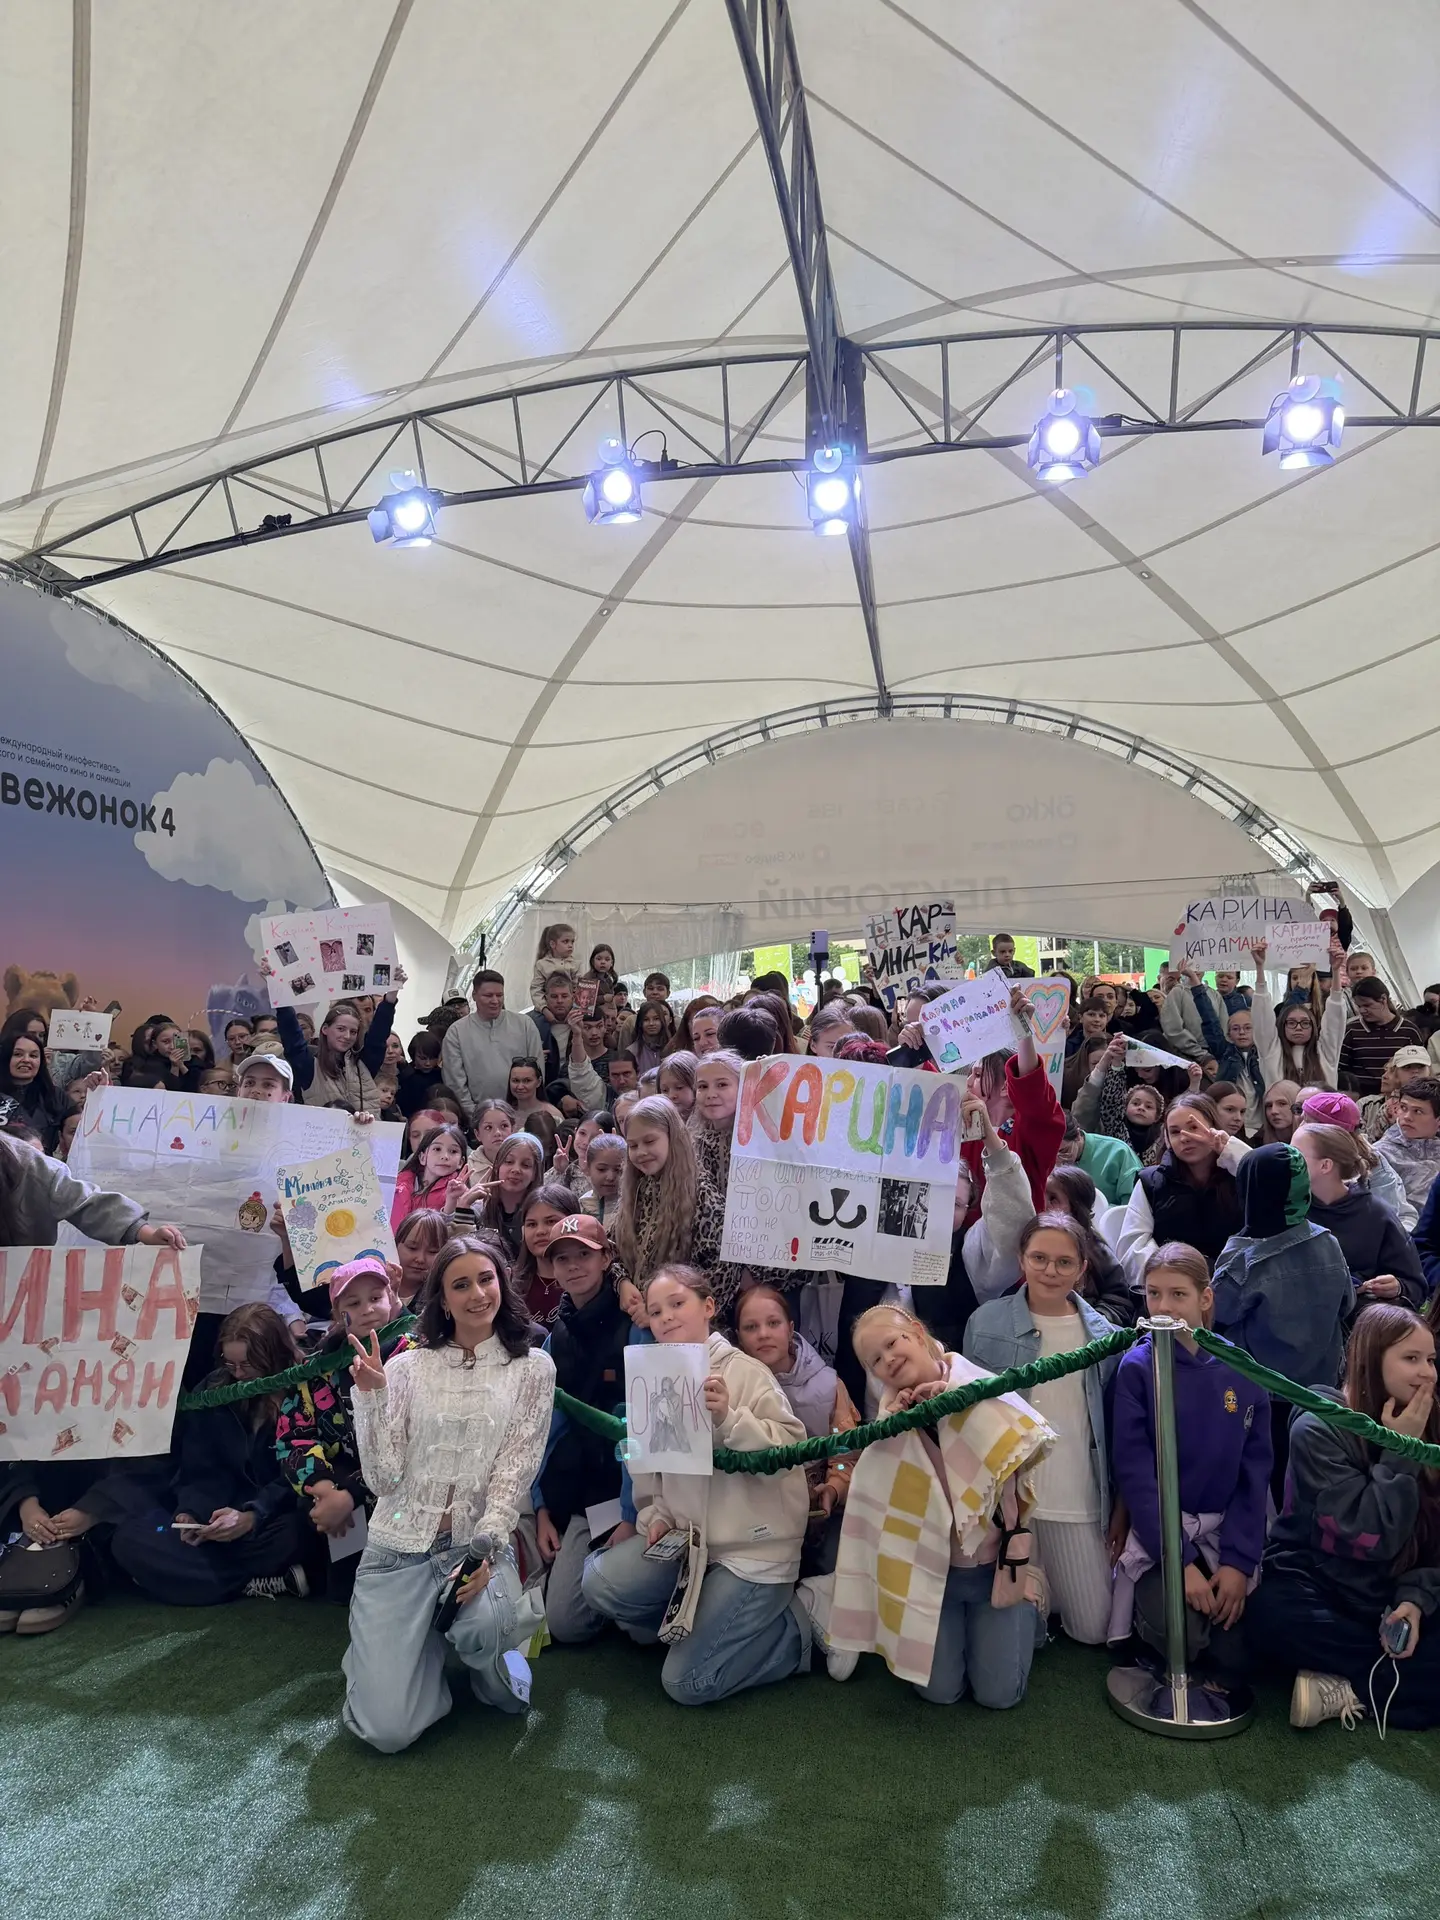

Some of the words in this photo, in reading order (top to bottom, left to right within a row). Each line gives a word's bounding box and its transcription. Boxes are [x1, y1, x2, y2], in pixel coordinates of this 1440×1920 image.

[25, 756, 69, 773] семейного
[70, 767, 88, 778] кино
[96, 773, 131, 788] анимации
[64, 754, 121, 774] кинофестиваль
[1185, 898, 1293, 924] КАРИНА
[1272, 922, 1330, 938] КАРИНА
[737, 1061, 960, 1164] КАРИНА
[765, 1216, 778, 1230] не
